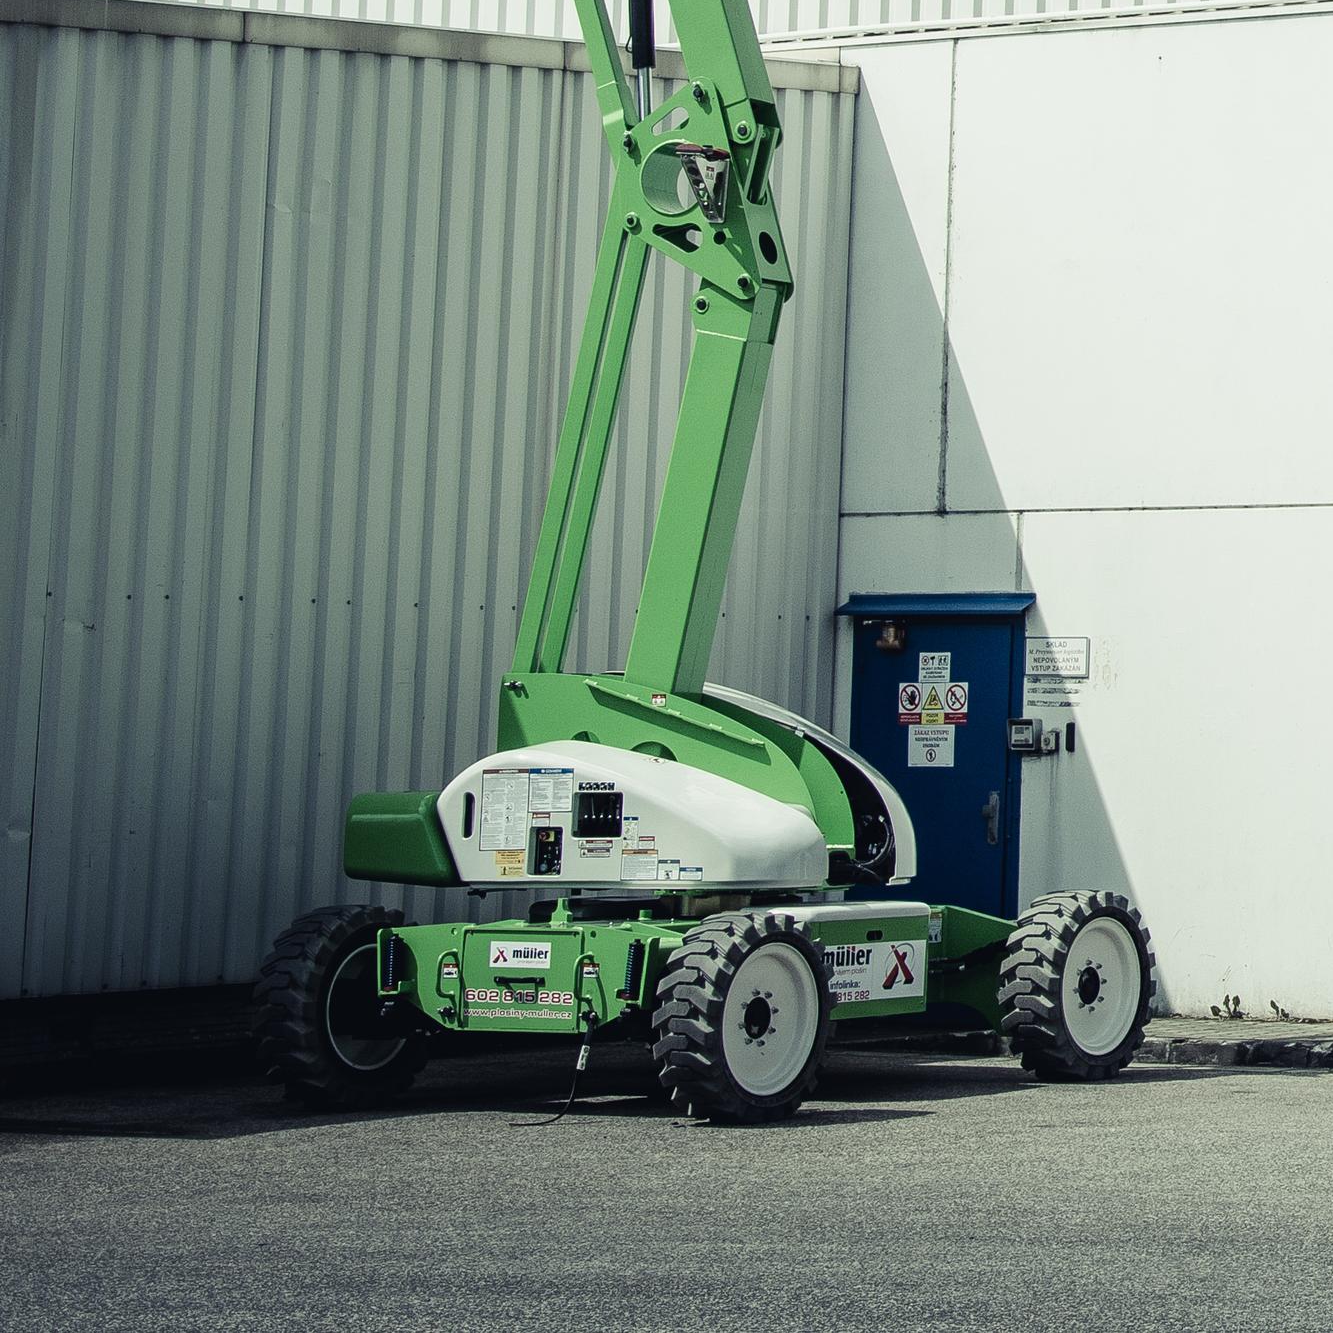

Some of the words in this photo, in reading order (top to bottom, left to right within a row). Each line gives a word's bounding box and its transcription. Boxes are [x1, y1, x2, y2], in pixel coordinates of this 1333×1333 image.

[512, 947, 549, 960] müller
[821, 945, 872, 967] müller
[829, 979, 861, 990] infolinka:
[465, 989, 499, 1002] 602
[503, 990, 536, 1004] 815
[539, 992, 573, 1005] 282
[836, 992, 853, 1002] 815
[854, 990, 871, 1001] 282
[464, 1008, 572, 1019] www.plosiny-muller.cz
